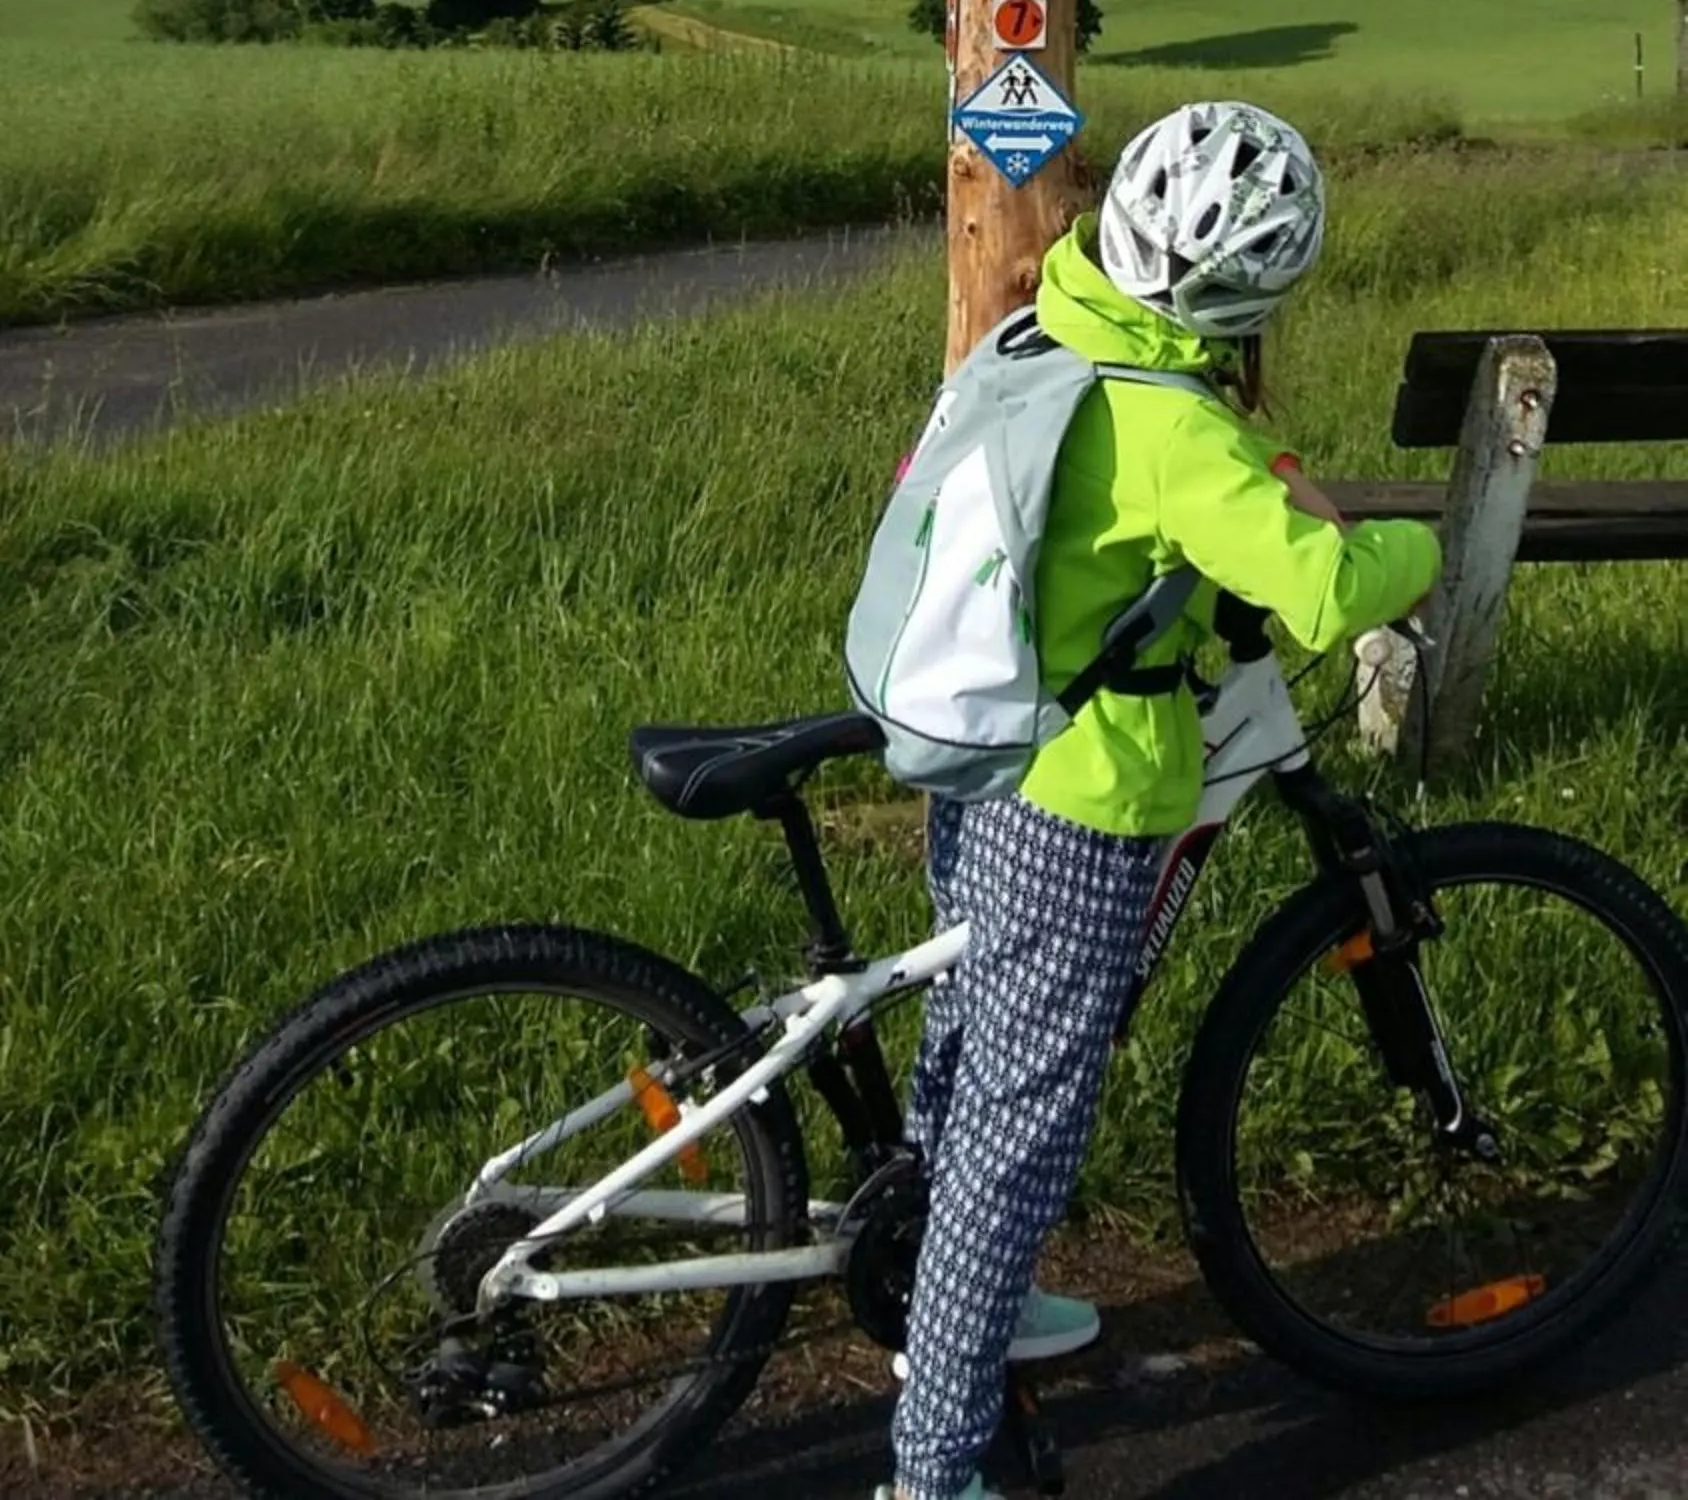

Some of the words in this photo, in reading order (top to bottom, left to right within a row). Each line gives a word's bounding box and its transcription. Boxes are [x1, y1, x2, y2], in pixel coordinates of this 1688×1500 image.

[1009, 2, 1026, 37] 7
[961, 115, 1074, 134] Winterwanderweg
[1135, 856, 1196, 979] SPECIALIZED
